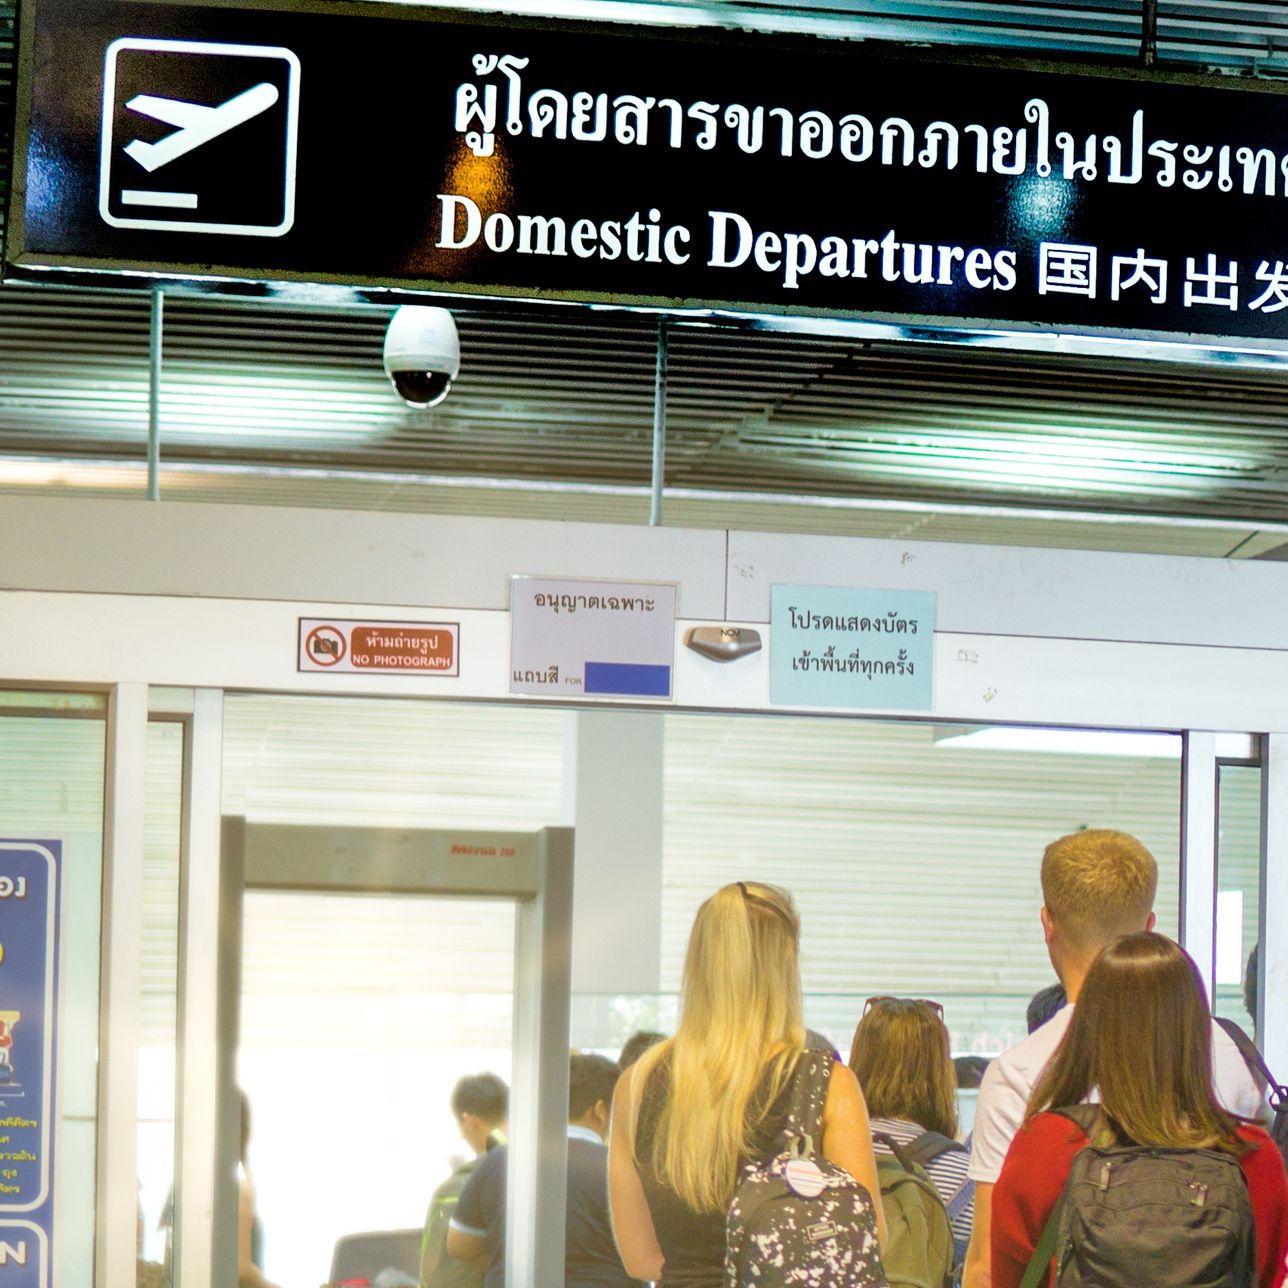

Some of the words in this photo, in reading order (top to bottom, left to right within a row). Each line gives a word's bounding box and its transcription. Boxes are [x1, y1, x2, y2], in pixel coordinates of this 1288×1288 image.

[435, 193, 691, 265] Domestic
[707, 210, 1017, 291] Departures
[534, 592, 655, 613] อนุญาตเฉพาะ
[788, 606, 918, 635] โปรดแสดงบัตร
[366, 630, 438, 655] ห้ามถ่ายรูป
[352, 655, 369, 665] NO
[374, 656, 451, 667] PHOTOGRAPH
[792, 646, 915, 681] เข้าพื้นที่ทุกครั้ง
[513, 665, 559, 685] แถบสี
